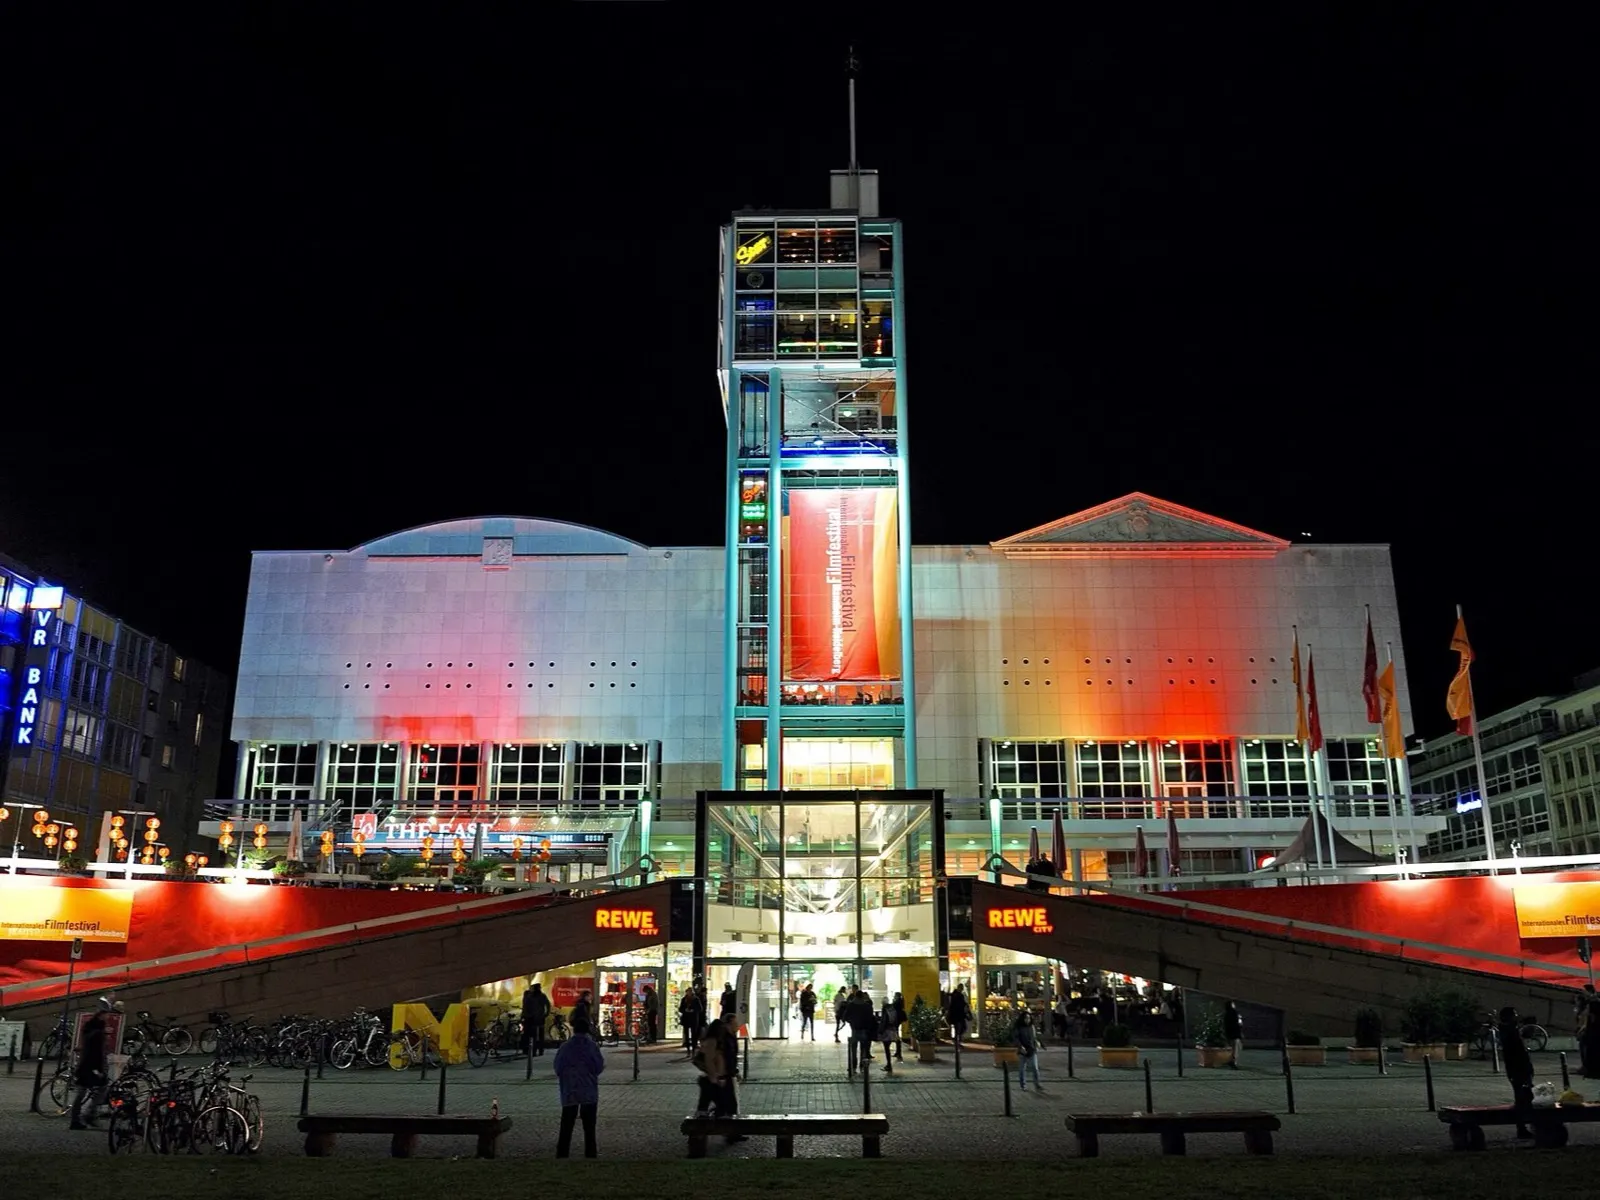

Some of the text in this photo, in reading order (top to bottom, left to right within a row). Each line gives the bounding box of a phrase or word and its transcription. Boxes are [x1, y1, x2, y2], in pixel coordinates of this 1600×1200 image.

[826, 507, 841, 584] Filmfestival
[841, 555, 857, 633] Filmfestival
[17, 610, 51, 744] VR BANK
[384, 823, 431, 839] THE
[438, 823, 492, 839] EAST
[44, 919, 100, 931] Filmfestival
[595, 909, 654, 929] REWE
[988, 908, 1048, 928] REWE
